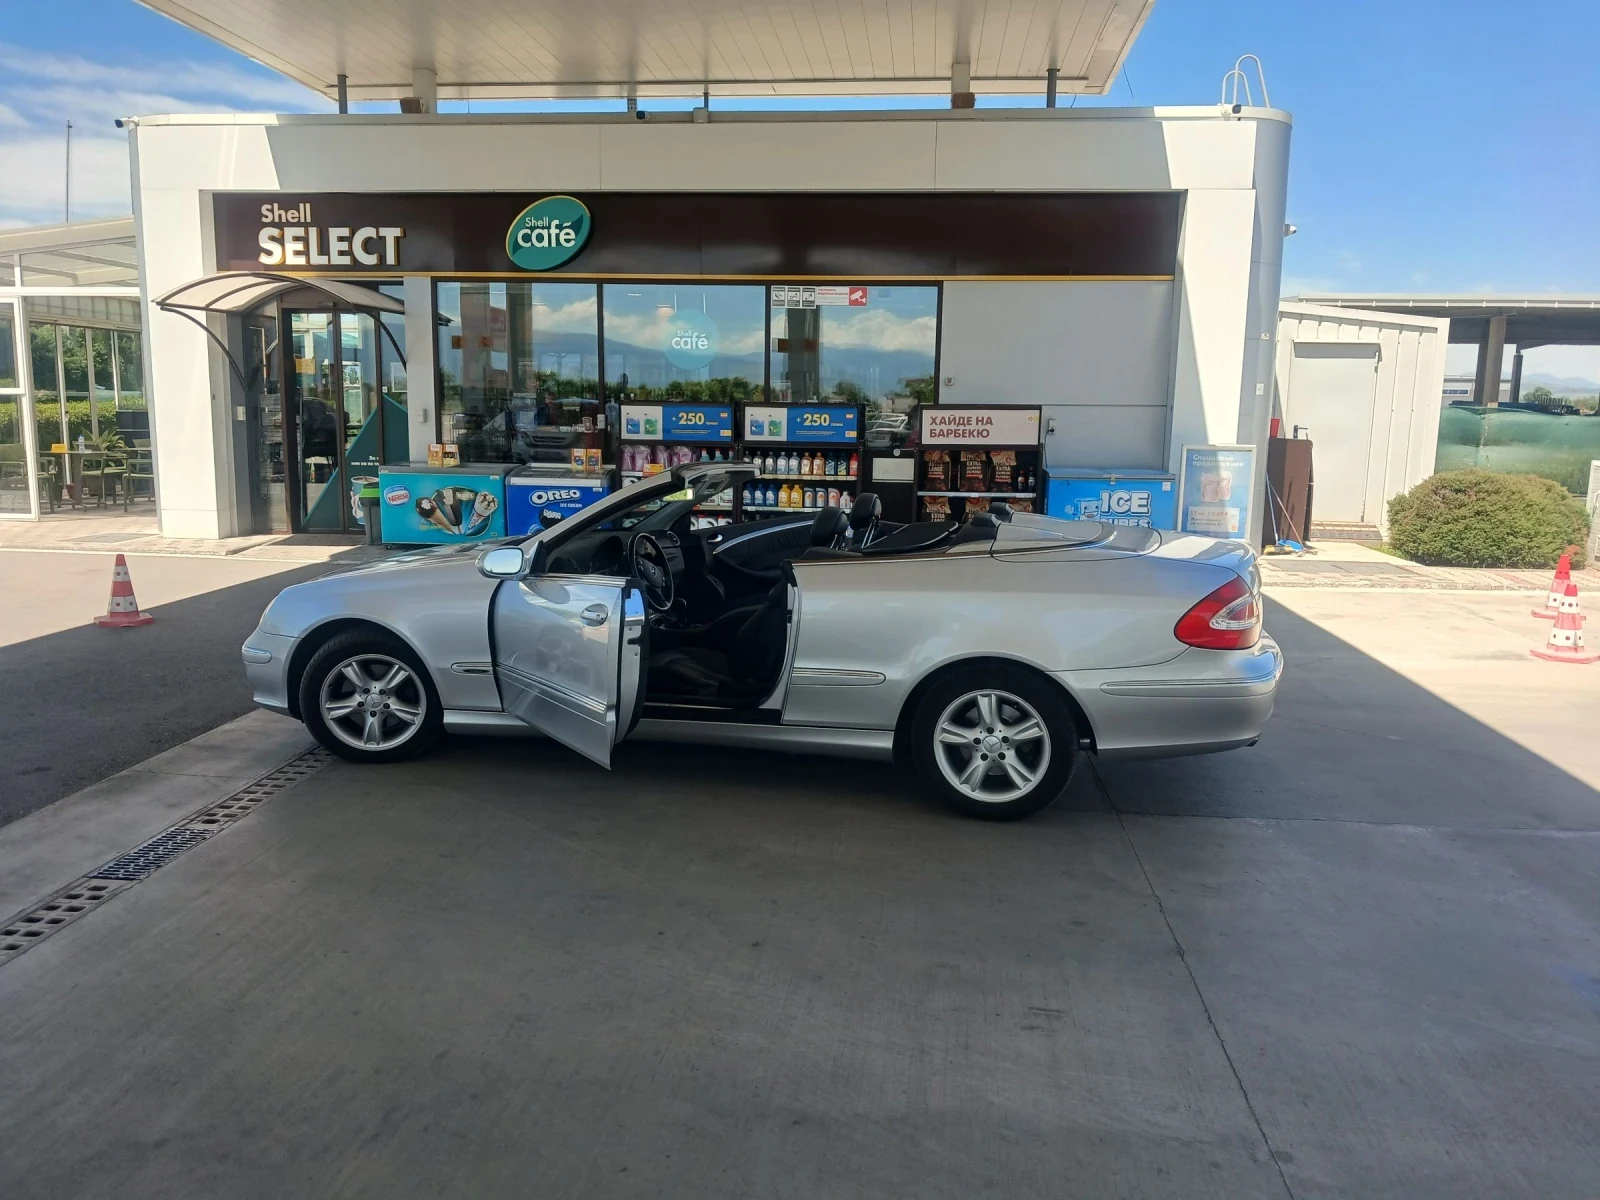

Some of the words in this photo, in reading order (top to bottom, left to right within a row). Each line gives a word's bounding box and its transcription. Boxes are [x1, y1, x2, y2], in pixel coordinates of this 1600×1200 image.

[261, 203, 311, 223] Shell
[525, 216, 549, 227] Shell
[517, 219, 576, 248] café
[258, 227, 404, 265] SELECT
[676, 329, 692, 337] Shell
[671, 332, 708, 350] café
[678, 412, 705, 425] 250
[803, 413, 830, 426] 250
[929, 414, 973, 427] ХАЙДЕ
[975, 416, 994, 426] НА
[929, 428, 990, 438] БАРБЕКЮ
[531, 489, 581, 504] OREO
[1101, 491, 1149, 514] ICE
